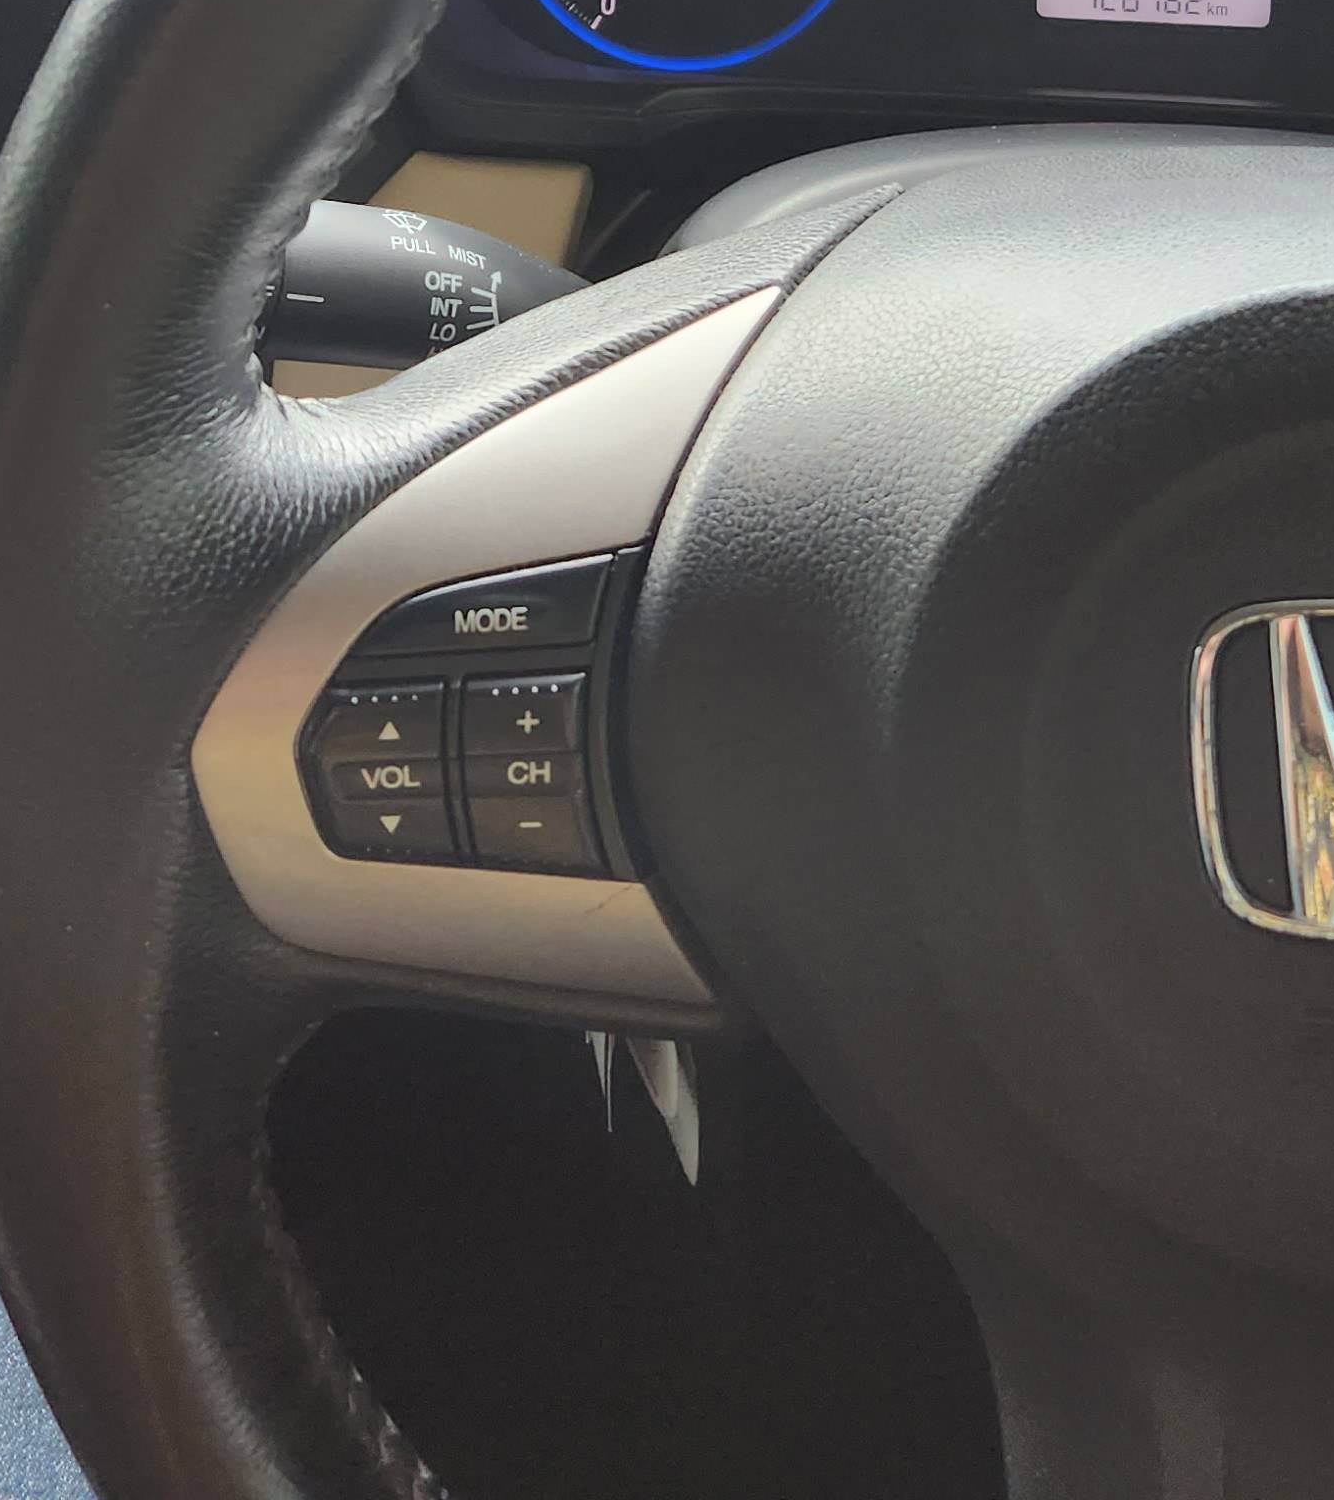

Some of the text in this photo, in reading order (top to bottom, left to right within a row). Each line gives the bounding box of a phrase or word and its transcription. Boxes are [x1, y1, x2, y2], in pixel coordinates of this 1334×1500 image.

[1207, 2, 1229, 17] km
[391, 236, 436, 255] PULL
[447, 244, 487, 270] MIST
[424, 270, 463, 293] OFF
[430, 296, 463, 318] INT
[429, 322, 456, 342] LO
[454, 606, 529, 634] MODE
[361, 765, 420, 790] VOL
[507, 761, 551, 785] CH
